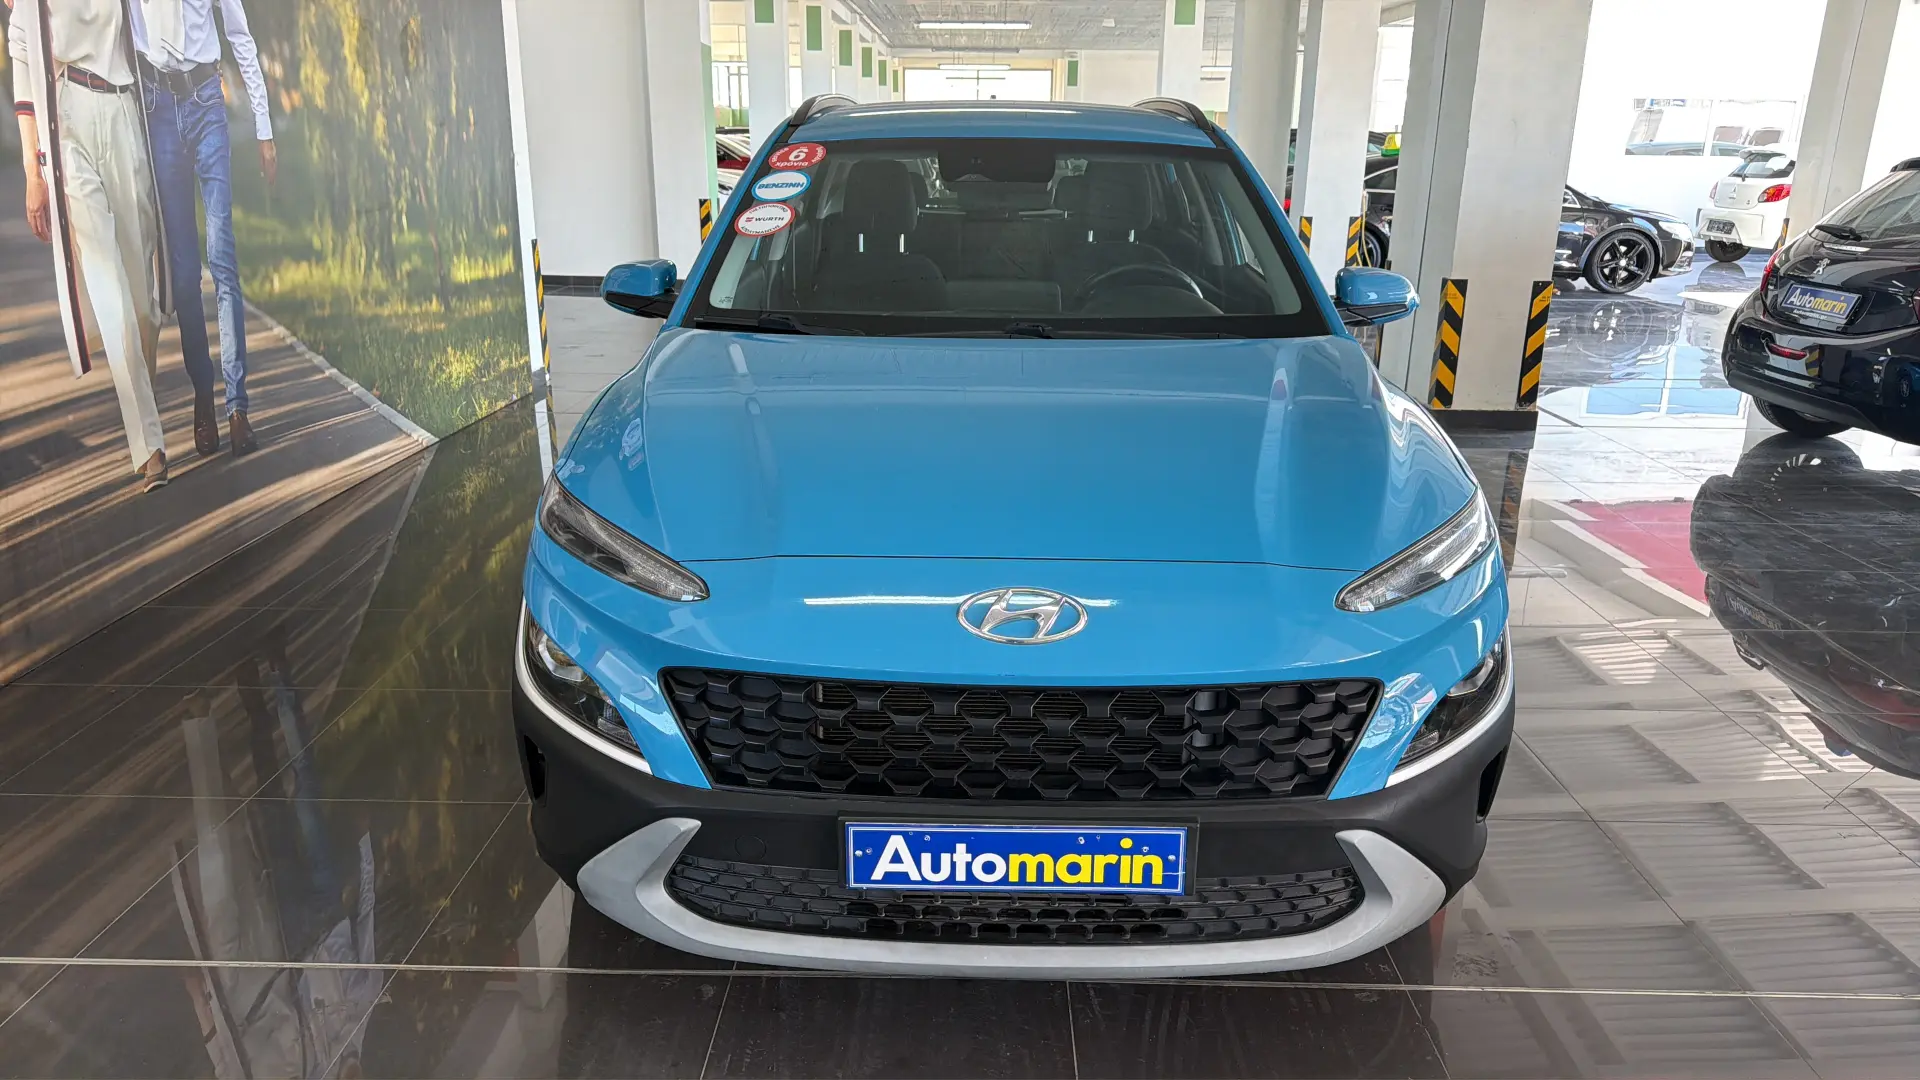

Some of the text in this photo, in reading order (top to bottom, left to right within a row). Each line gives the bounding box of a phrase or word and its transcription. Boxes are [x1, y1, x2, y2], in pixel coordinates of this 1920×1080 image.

[788, 148, 809, 161] 6
[1787, 288, 1847, 314] Automarin
[870, 834, 1163, 885] Automarin
